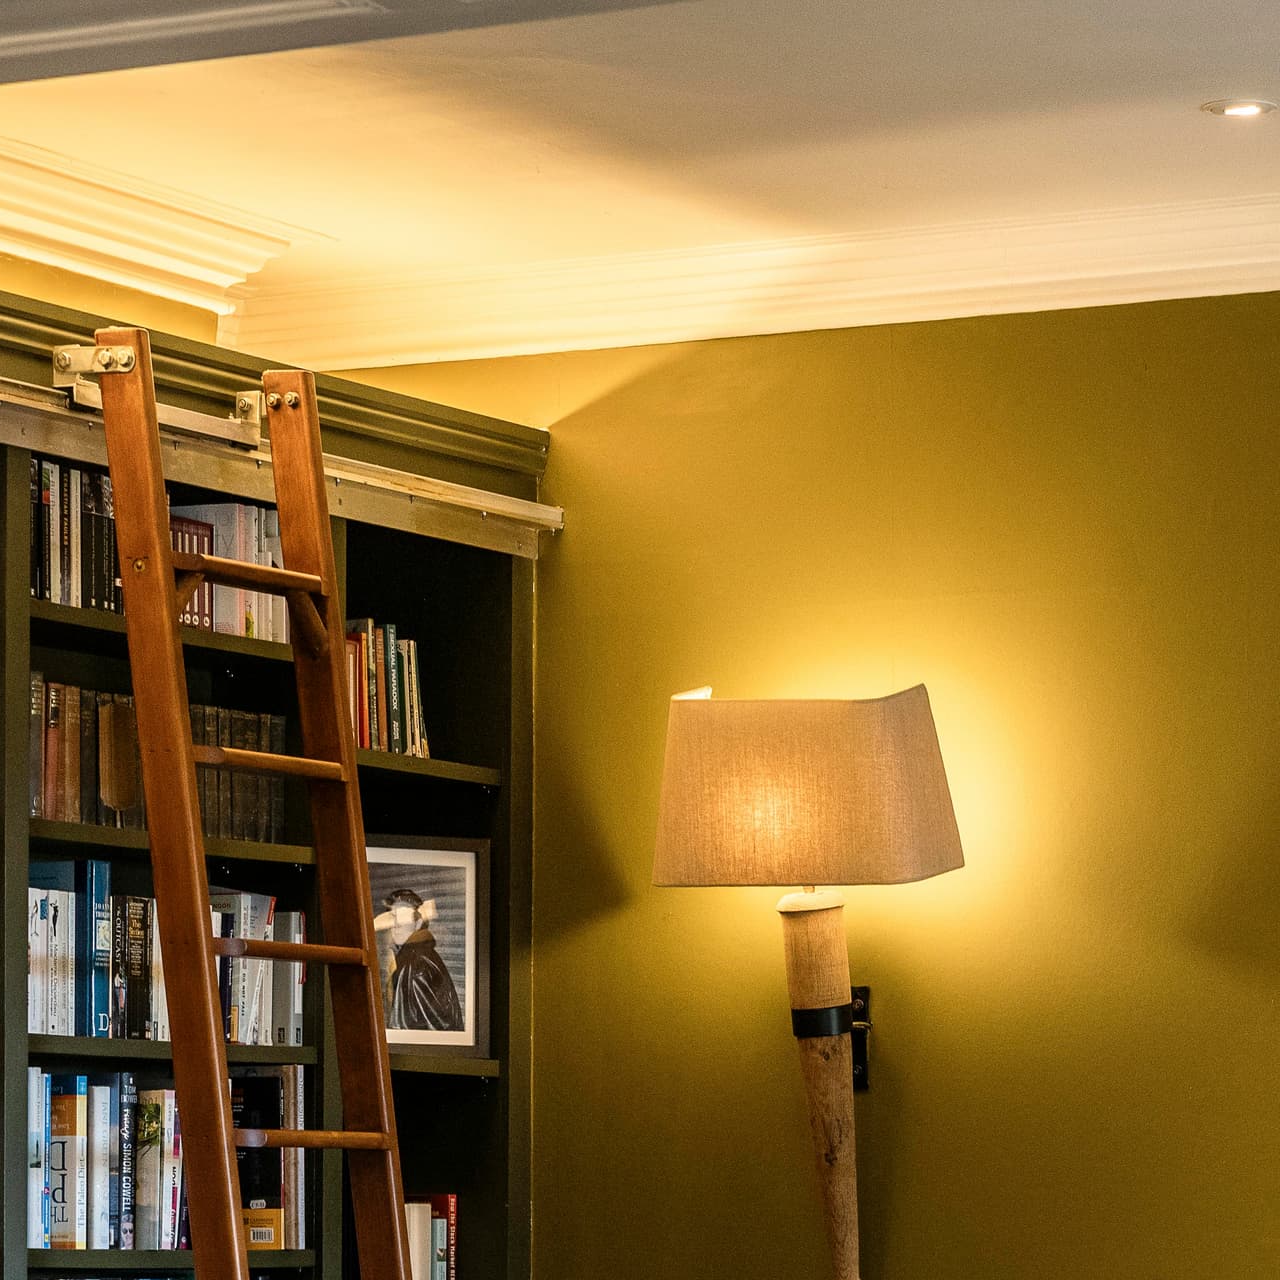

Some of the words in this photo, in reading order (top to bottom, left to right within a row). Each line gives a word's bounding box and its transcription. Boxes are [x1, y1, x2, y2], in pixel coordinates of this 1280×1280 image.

[390, 669, 398, 710] PARADOX
[114, 917, 123, 964] OUTCAST
[123, 1143, 131, 1174] SIMON
[122, 1176, 131, 1213] COWELL
